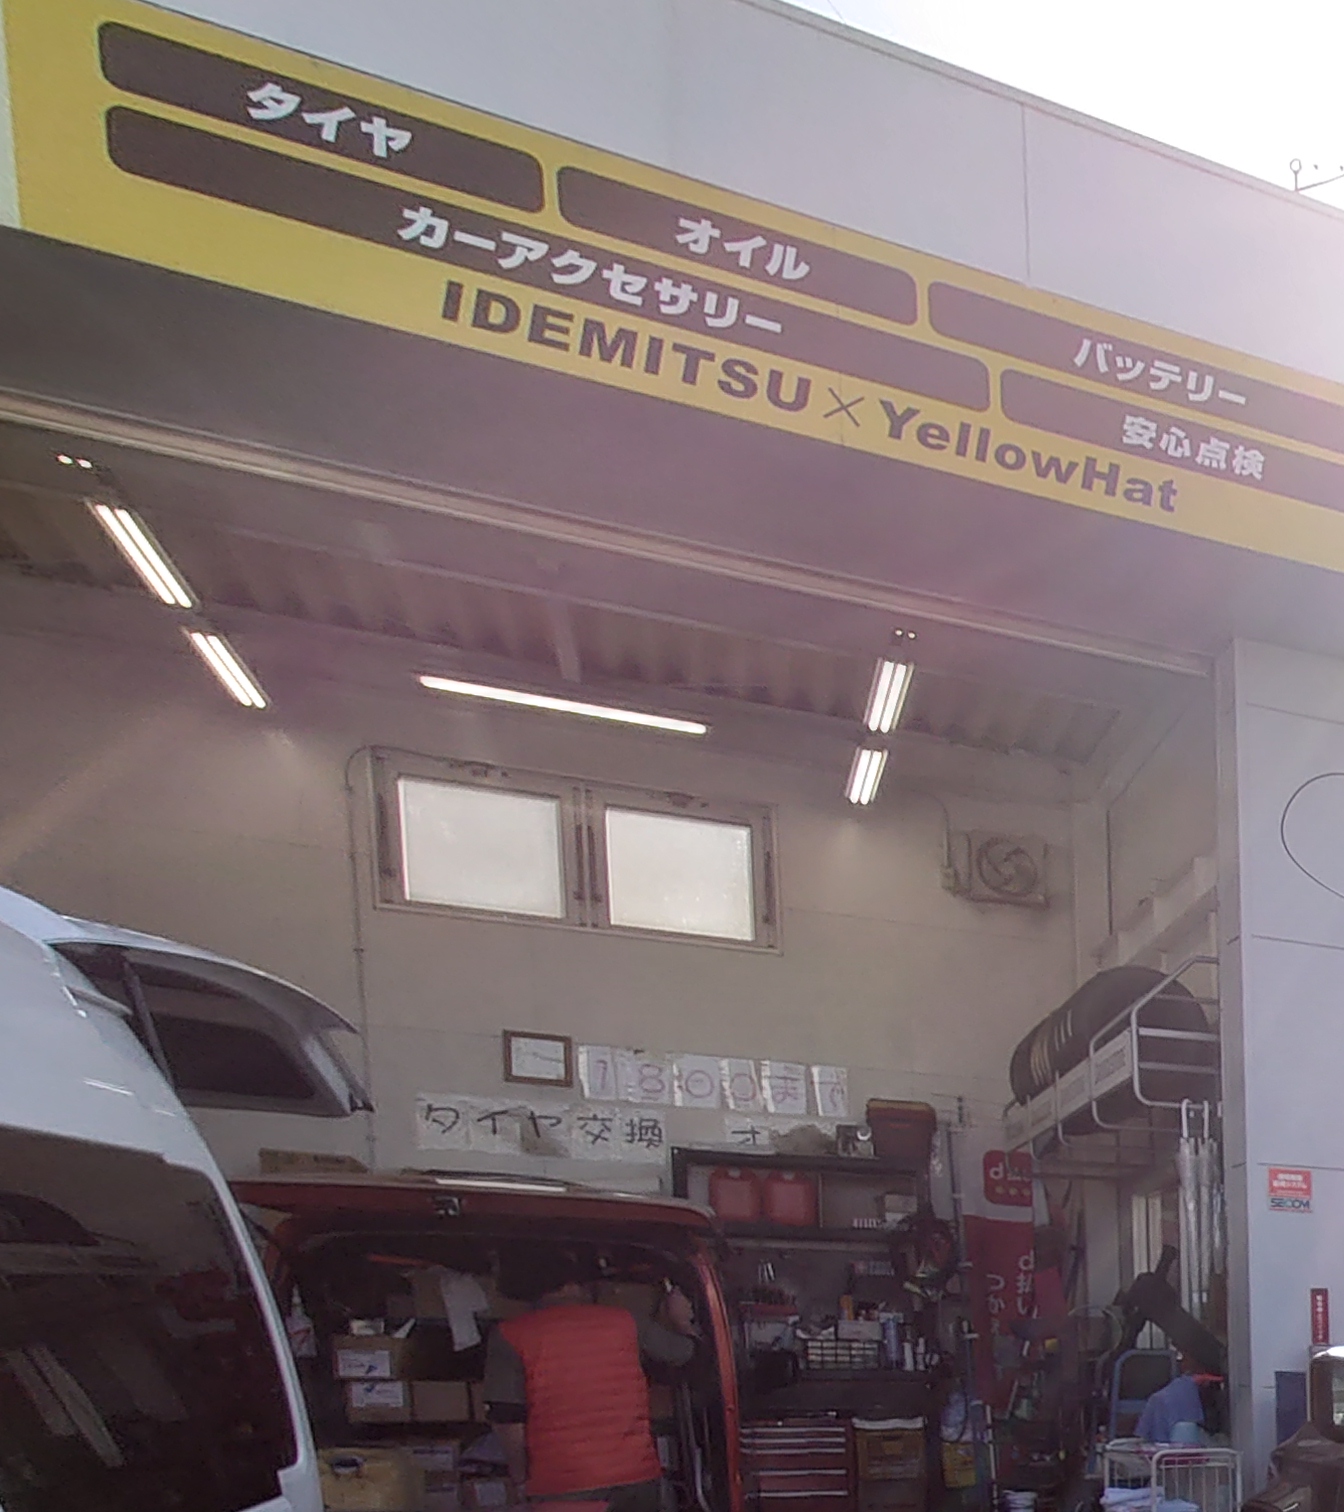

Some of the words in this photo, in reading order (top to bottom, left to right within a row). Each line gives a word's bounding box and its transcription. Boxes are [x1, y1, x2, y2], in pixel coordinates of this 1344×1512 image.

[246, 81, 413, 158] タイヤ
[397, 205, 783, 336] カーアクセサリー
[675, 214, 810, 282] オイル
[440, 279, 812, 413] IDEMITSU
[1073, 337, 1247, 406] バッテリー
[1122, 414, 1266, 480] 安心点検
[424, 1103, 663, 1148] タイヤ交換
[1270, 1197, 1310, 1209] SECOM
